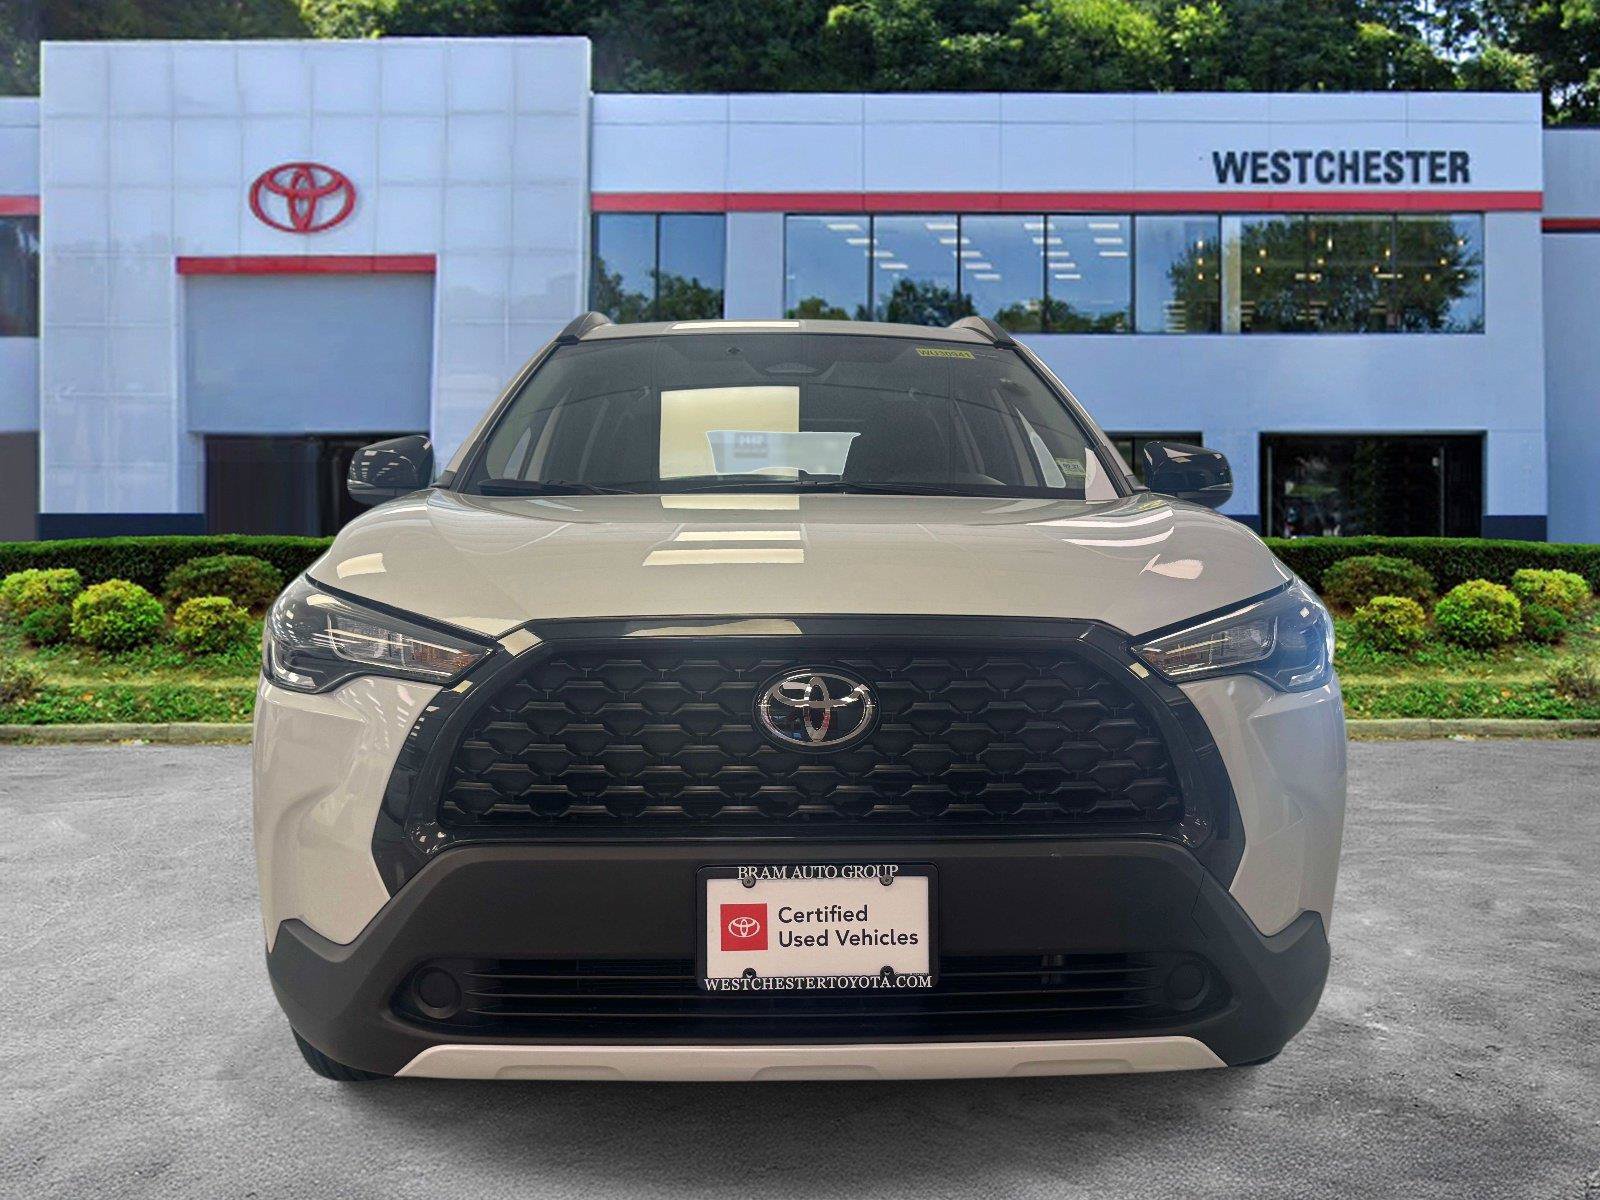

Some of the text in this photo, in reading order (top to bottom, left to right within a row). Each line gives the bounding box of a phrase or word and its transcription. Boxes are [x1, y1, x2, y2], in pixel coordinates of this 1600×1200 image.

[1212, 151, 1470, 184] WESTCHESTER
[737, 864, 899, 880] BRAM AUTO GROUP
[778, 905, 868, 924] Certified
[778, 929, 919, 947] Used Vehicles
[704, 975, 933, 991] WESTCHESTERTOYOTA.COM
